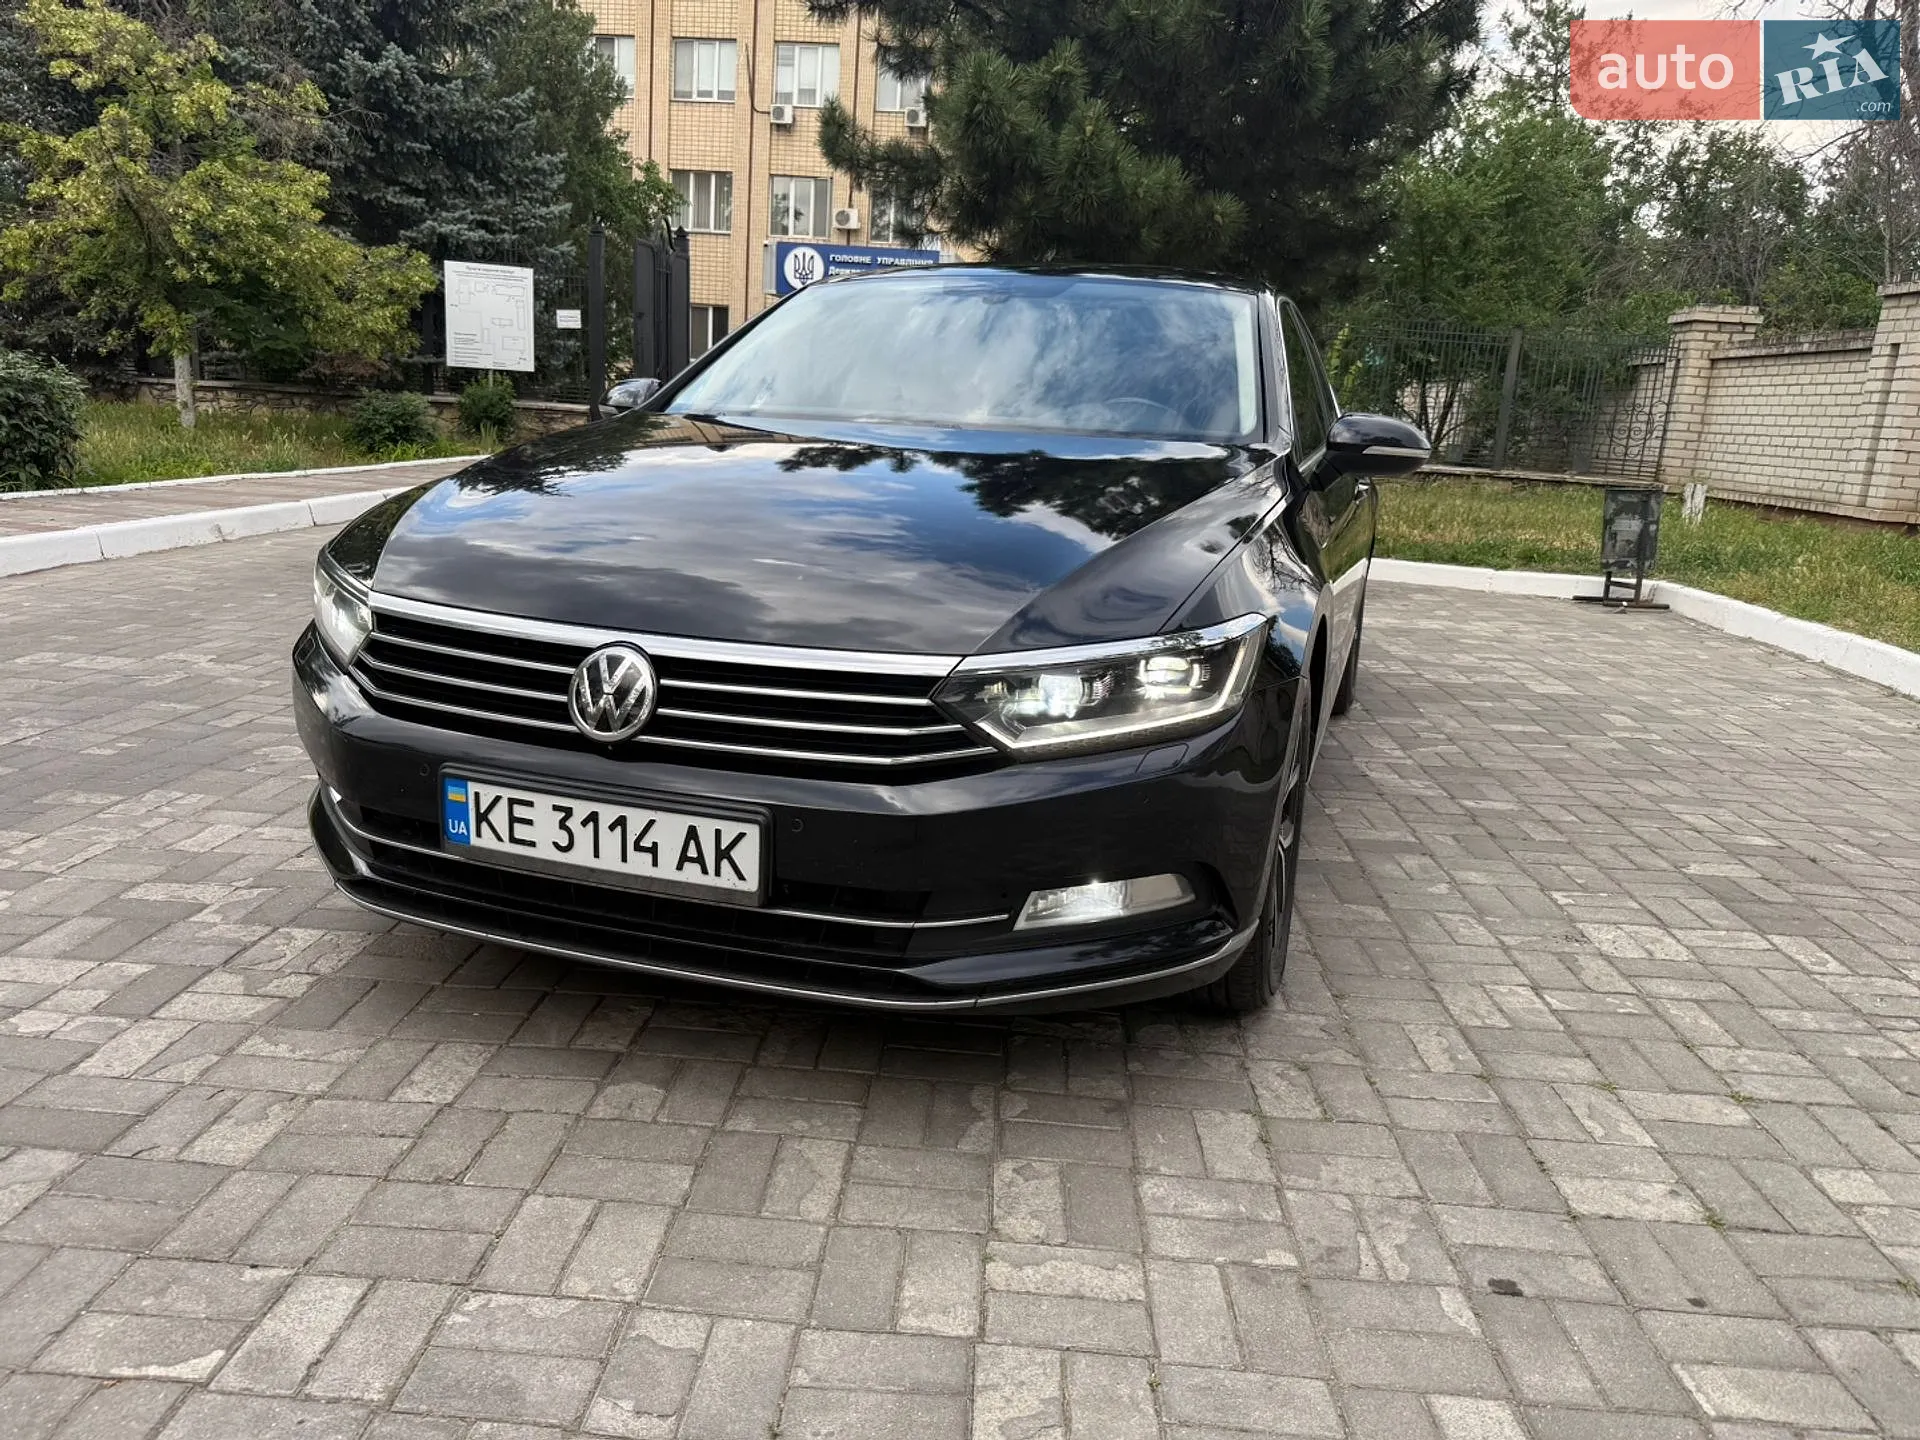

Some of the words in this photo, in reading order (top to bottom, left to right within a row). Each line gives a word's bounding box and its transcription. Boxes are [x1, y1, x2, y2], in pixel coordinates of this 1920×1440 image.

[829, 254, 872, 264] ГОЛОВНЕ
[447, 818, 468, 836] UA
[473, 791, 537, 848] KE
[551, 804, 659, 868] 3114
[675, 824, 747, 881] AK
